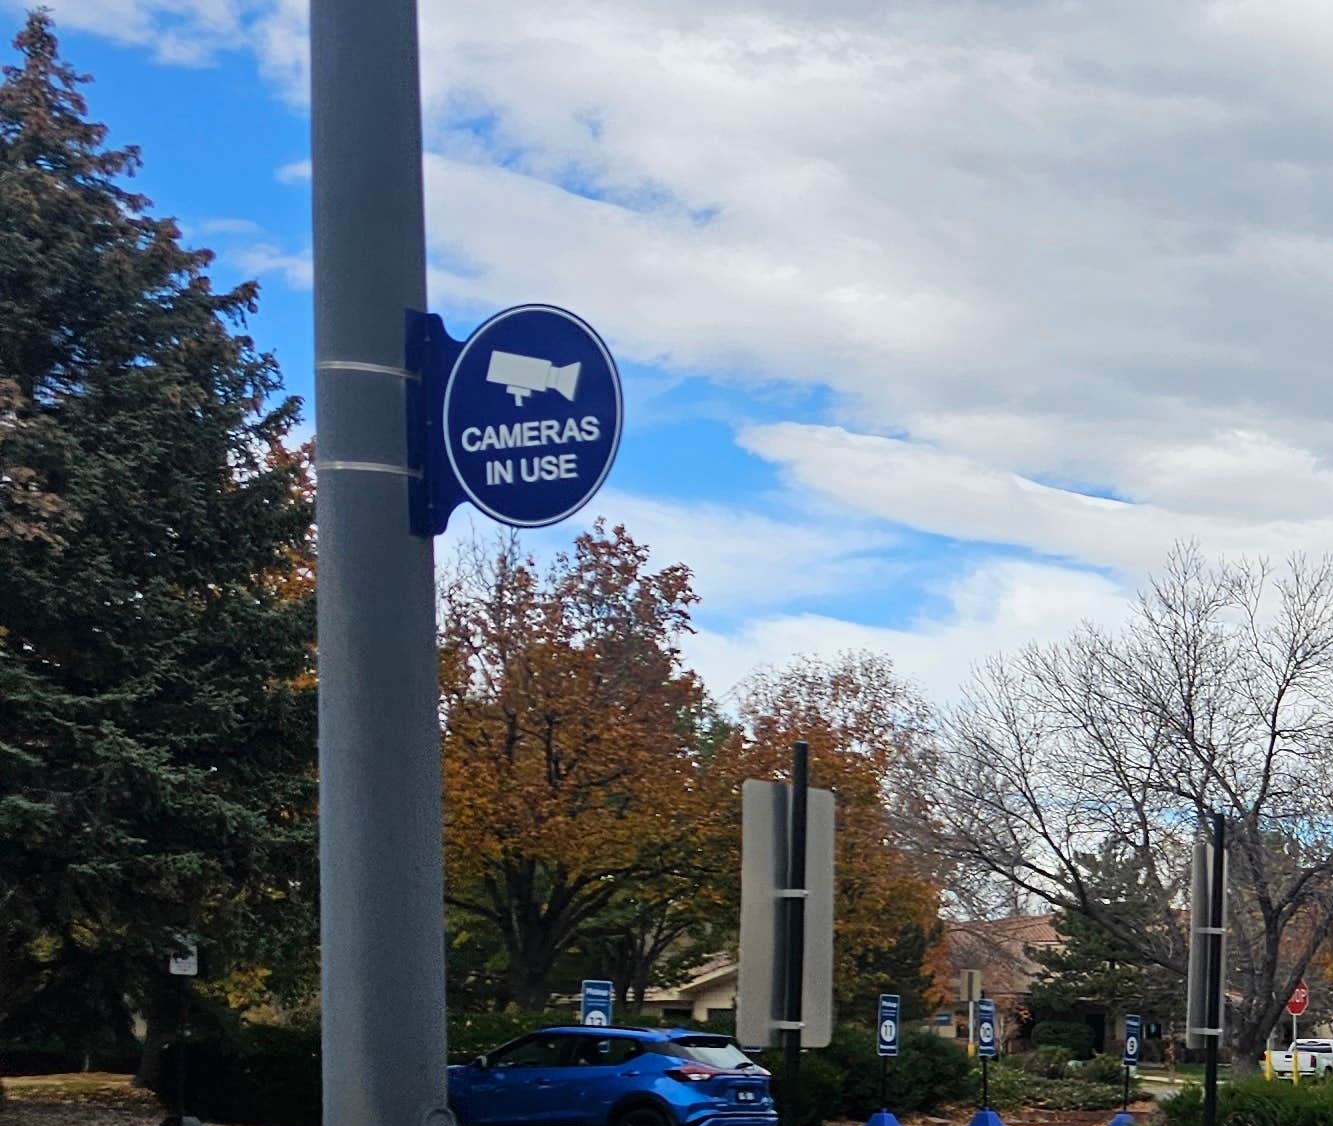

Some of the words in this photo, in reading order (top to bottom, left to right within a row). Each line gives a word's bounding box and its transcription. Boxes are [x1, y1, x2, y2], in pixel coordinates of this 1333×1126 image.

[461, 415, 600, 452] CAMERAS
[486, 459, 513, 486] IN
[520, 454, 579, 483] USE
[884, 1024, 893, 1037] 11
